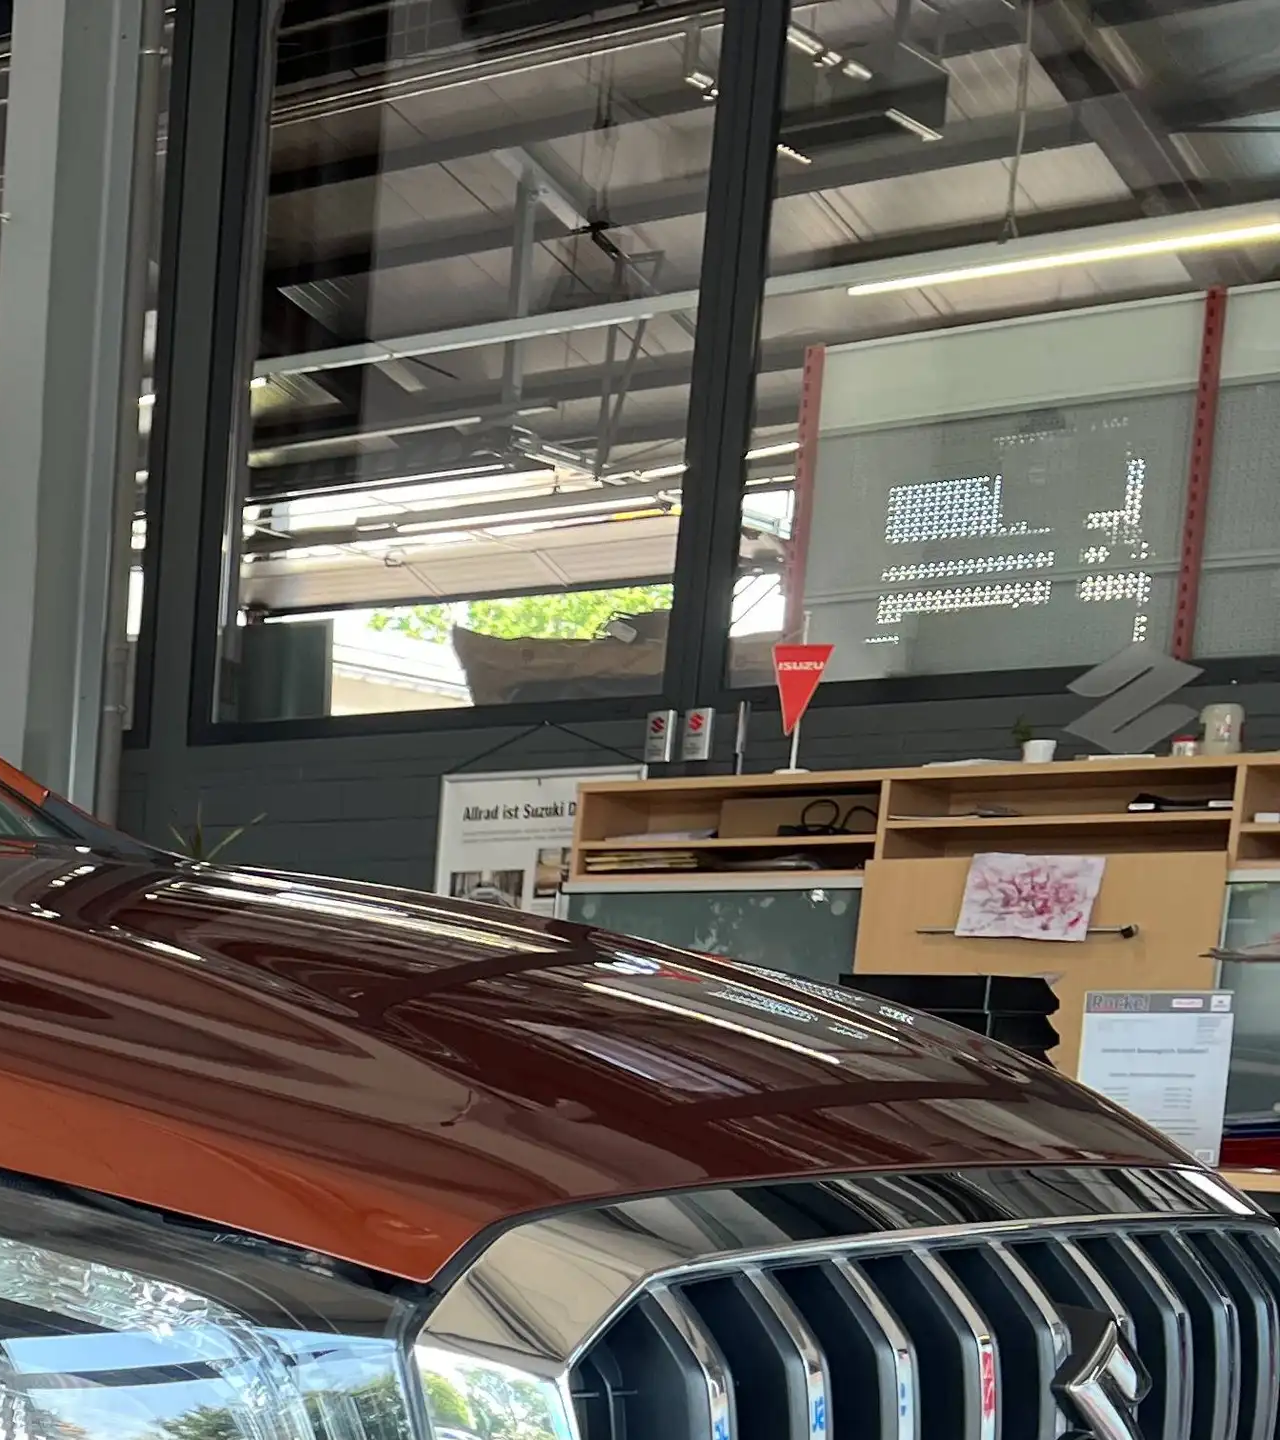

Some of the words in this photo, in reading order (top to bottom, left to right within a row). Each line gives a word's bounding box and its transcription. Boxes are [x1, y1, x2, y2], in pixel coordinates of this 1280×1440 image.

[778, 661, 824, 671] ISUZU
[462, 806, 499, 821] Allrad
[502, 804, 519, 819] ist
[523, 800, 564, 819] Suzuki
